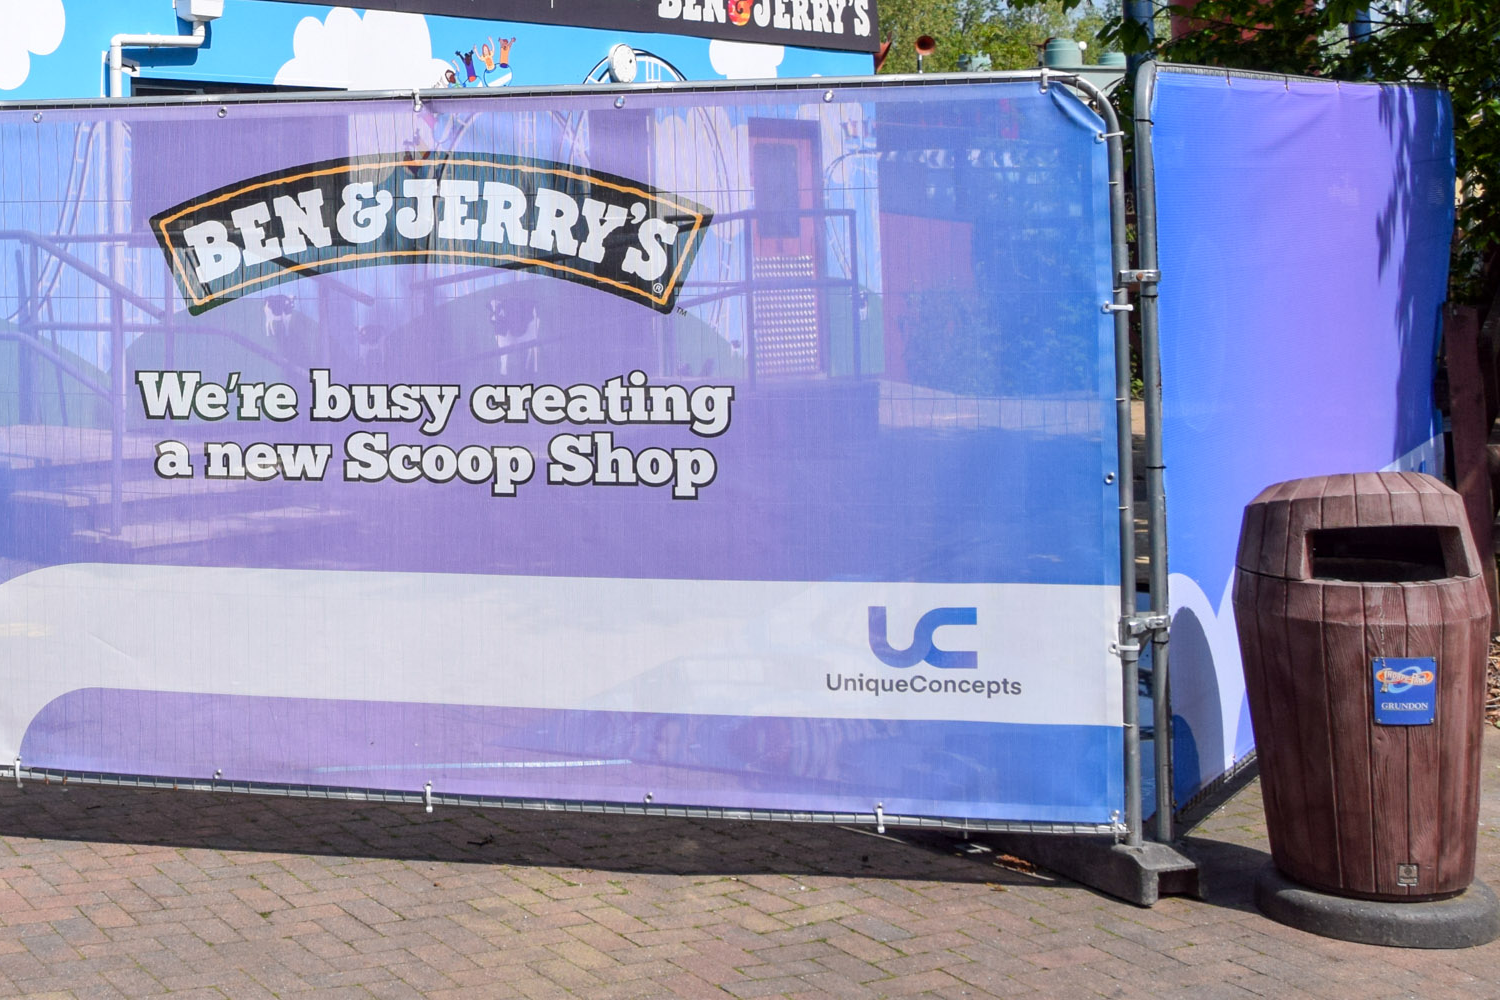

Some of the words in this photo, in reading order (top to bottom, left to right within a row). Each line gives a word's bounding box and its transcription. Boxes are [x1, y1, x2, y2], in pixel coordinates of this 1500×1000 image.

[135, 369, 299, 421] We're
[308, 368, 461, 435] busy
[470, 369, 734, 436] creating
[154, 439, 193, 479] a
[200, 440, 333, 481] new
[345, 431, 535, 497] Scoop
[546, 432, 718, 500] Shop
[826, 672, 1022, 699] UniqueConcepts
[1381, 702, 1429, 711] GRUNDON
